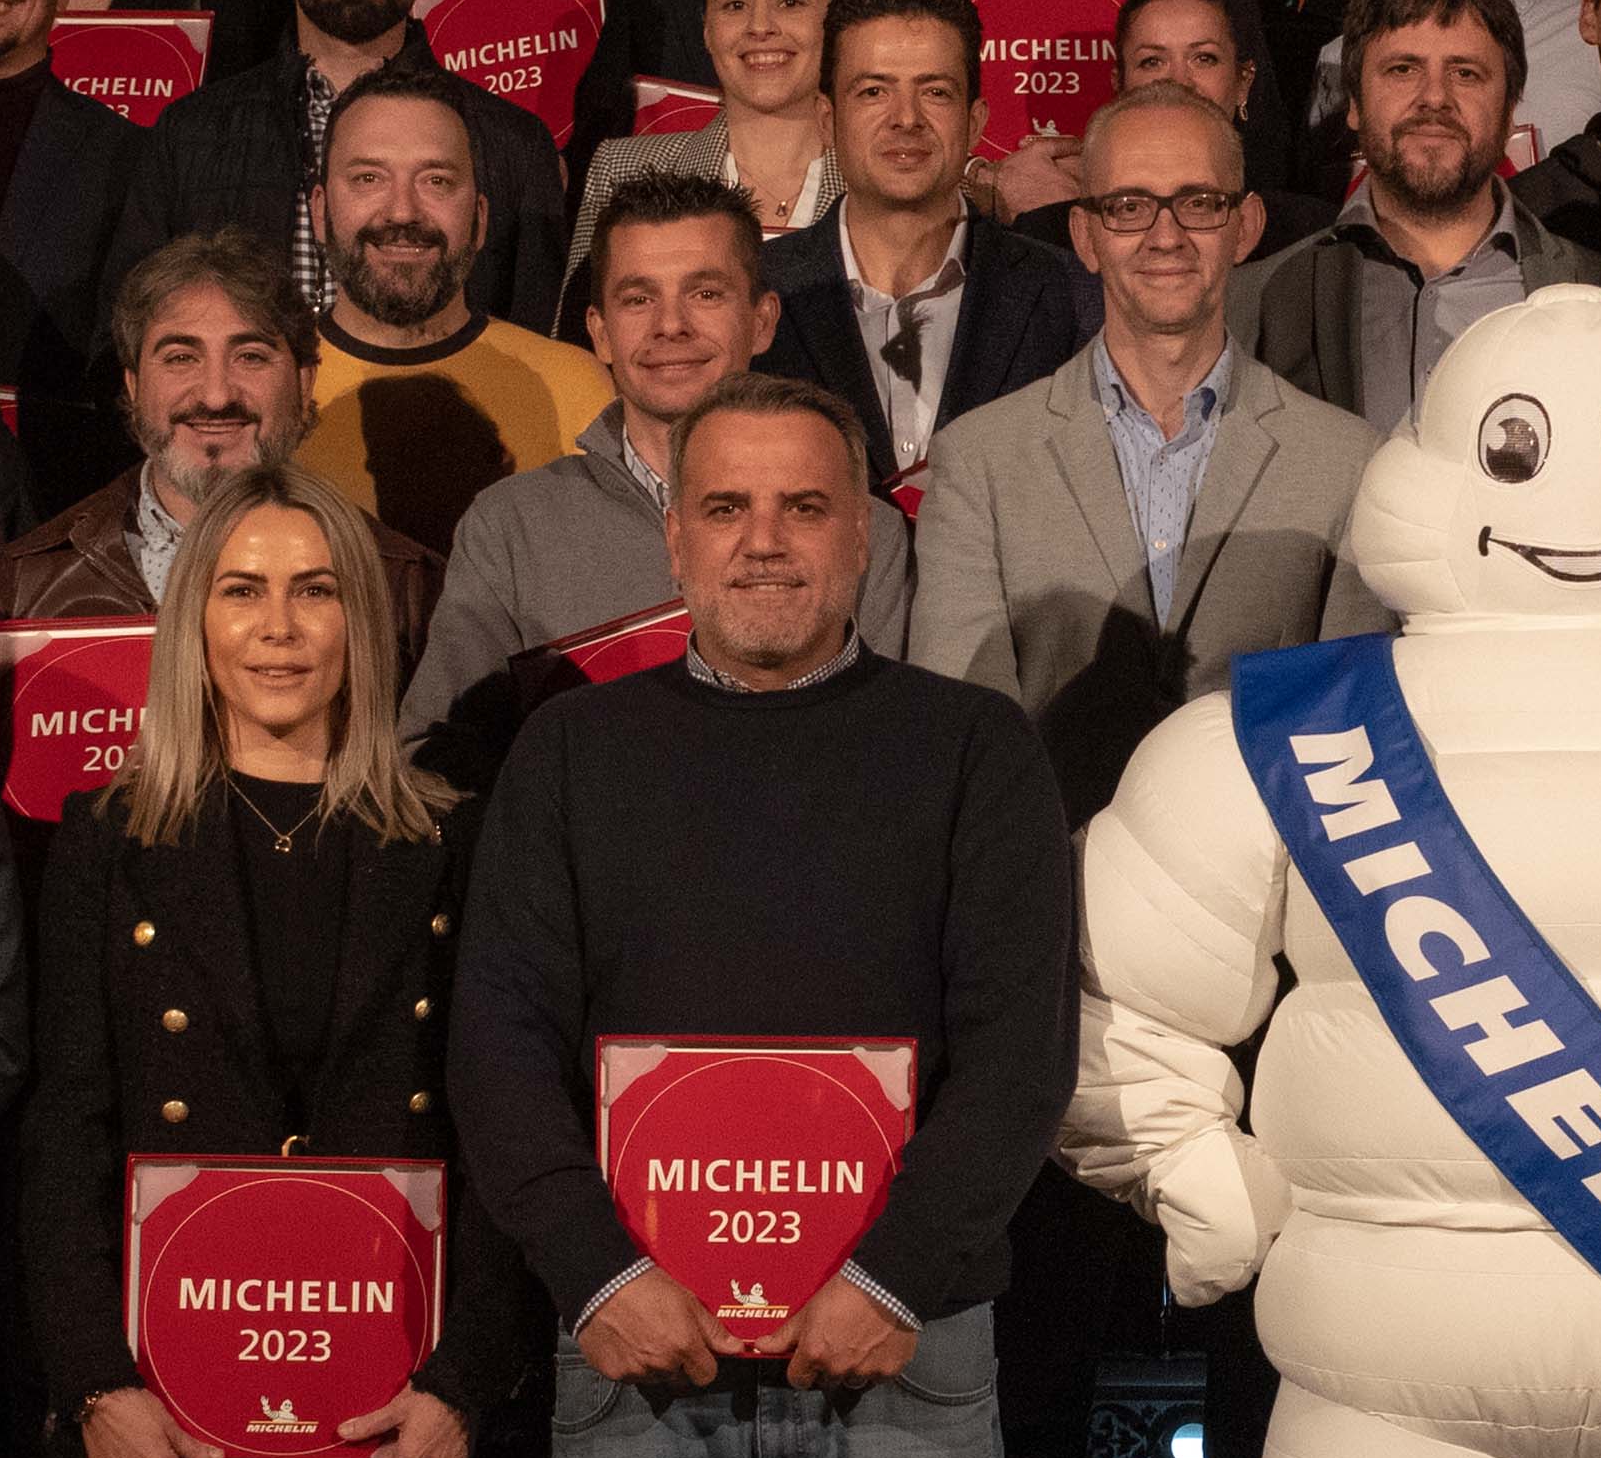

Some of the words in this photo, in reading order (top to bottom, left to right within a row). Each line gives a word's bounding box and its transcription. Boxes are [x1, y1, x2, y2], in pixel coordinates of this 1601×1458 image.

[444, 29, 577, 72] MICHELIN
[485, 66, 542, 94] 2023
[1014, 72, 1079, 94] 2023
[31, 707, 148, 737] MICH
[648, 1159, 863, 1193] MICHELIN
[708, 1210, 800, 1243] 2023
[180, 1278, 393, 1312] MICHELIN
[716, 1308, 789, 1320] MICHELIN
[238, 1329, 331, 1362] 2023
[245, 1422, 318, 1435] MICHELIN
